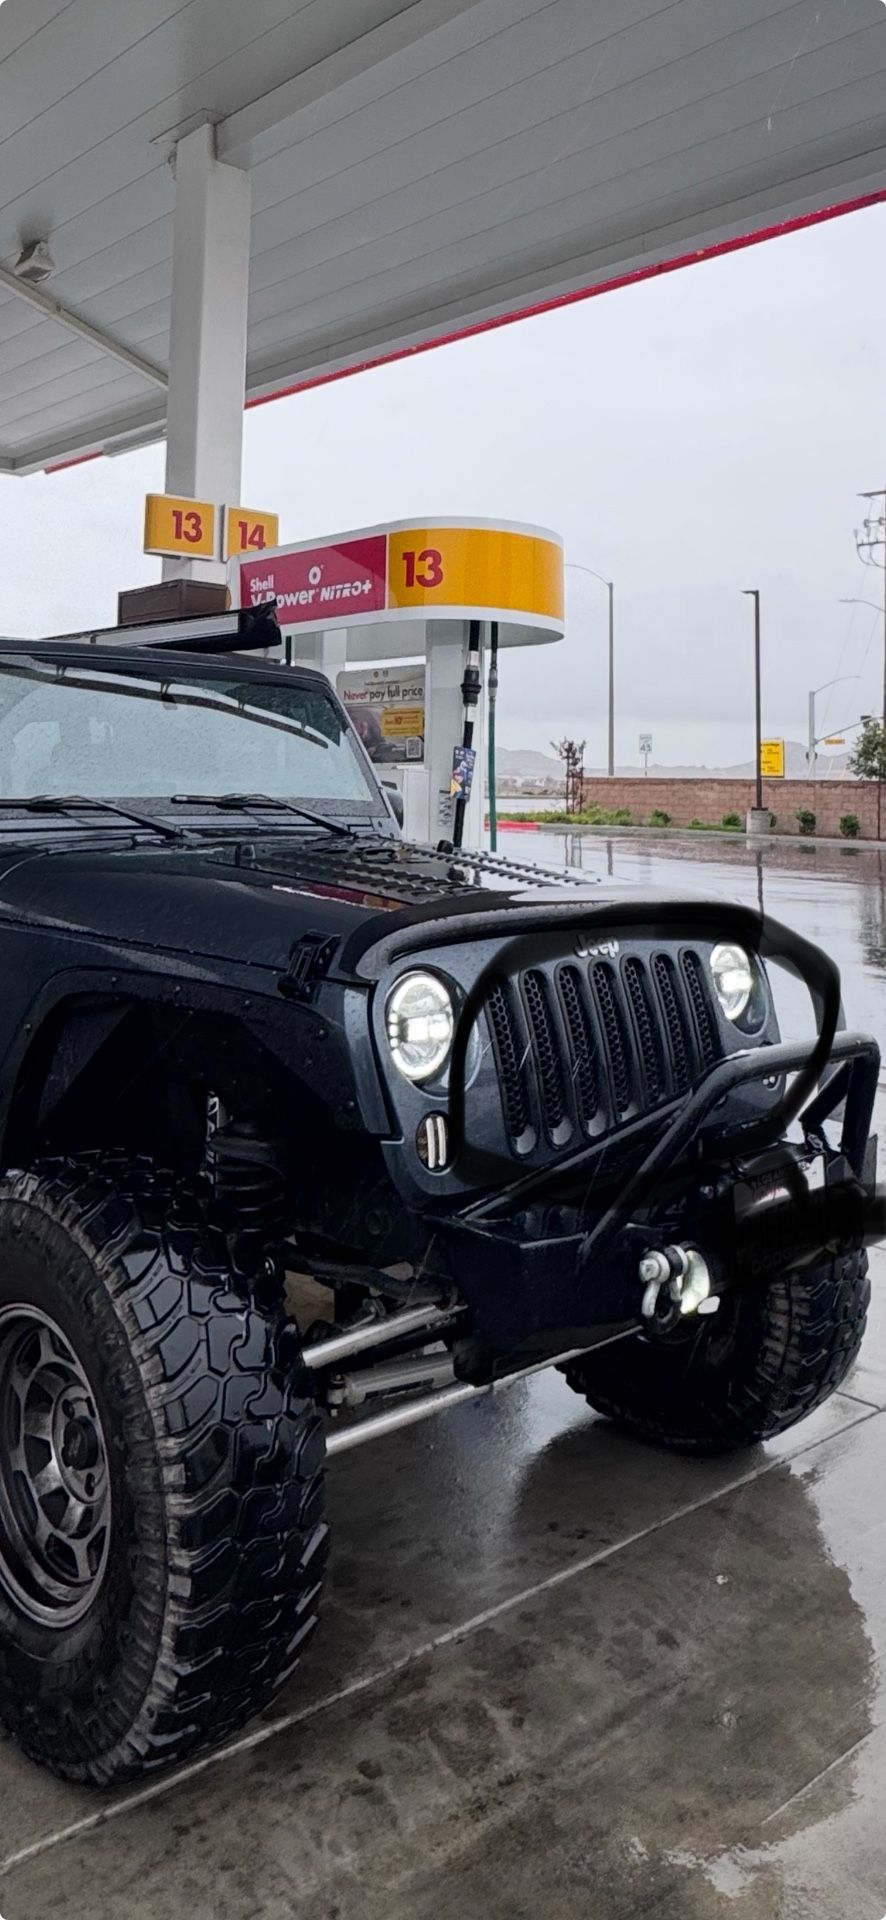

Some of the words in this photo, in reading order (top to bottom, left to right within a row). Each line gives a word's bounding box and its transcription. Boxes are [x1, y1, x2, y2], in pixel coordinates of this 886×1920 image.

[172, 510, 203, 543] 13
[238, 521, 266, 551] 14
[250, 574, 274, 592] Shell
[402, 549, 443, 588] 13
[343, 690, 368, 701] Never
[369, 690, 385, 702] pay
[387, 685, 400, 698] full
[401, 685, 423, 701] price
